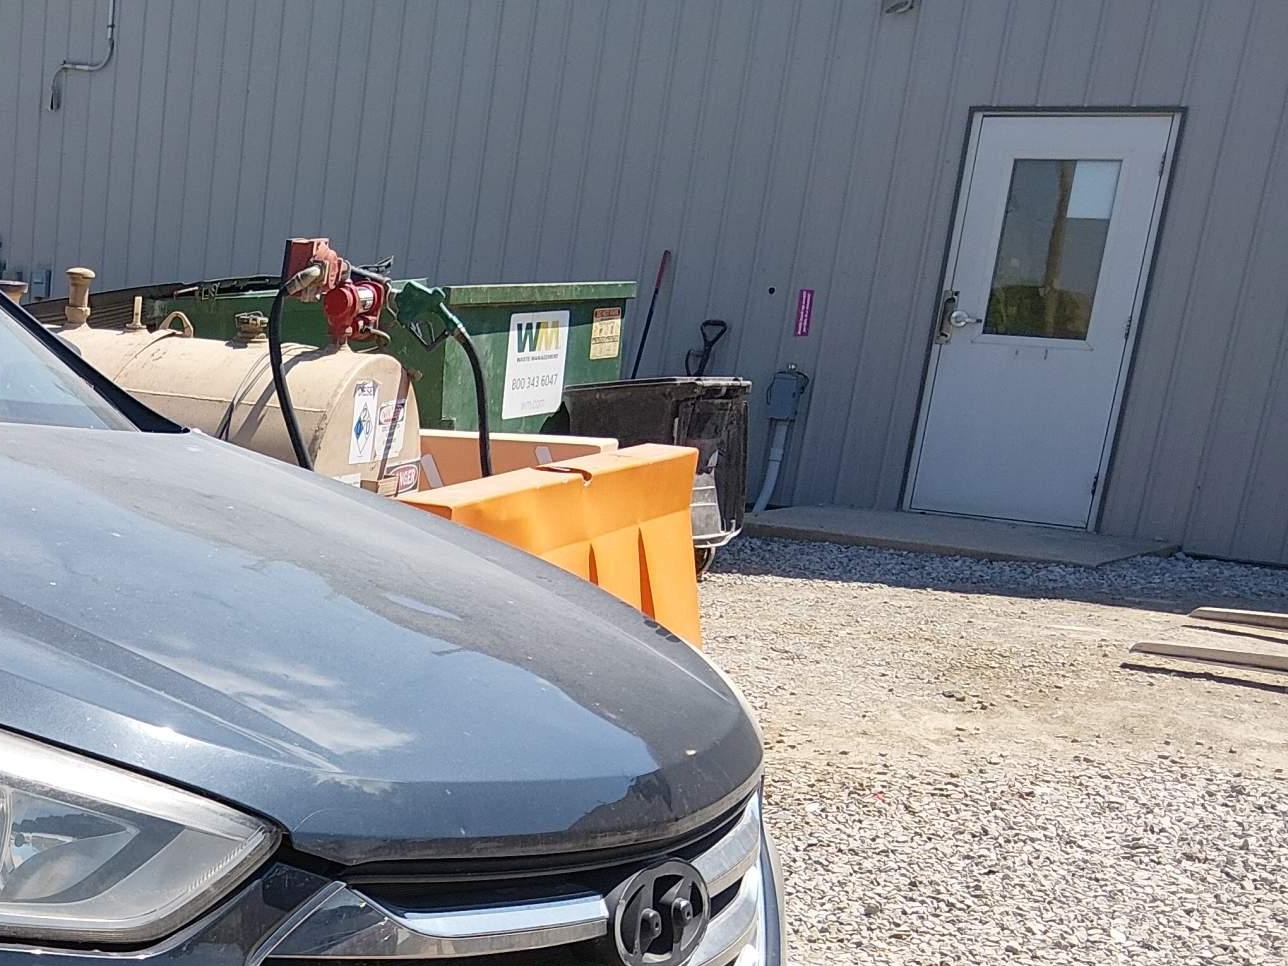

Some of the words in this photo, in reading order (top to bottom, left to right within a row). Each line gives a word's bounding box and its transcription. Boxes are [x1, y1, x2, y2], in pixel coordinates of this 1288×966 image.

[517, 321, 560, 353] WM
[511, 377, 525, 391] 800
[527, 375, 540, 389] 343
[541, 374, 558, 388] 6047
